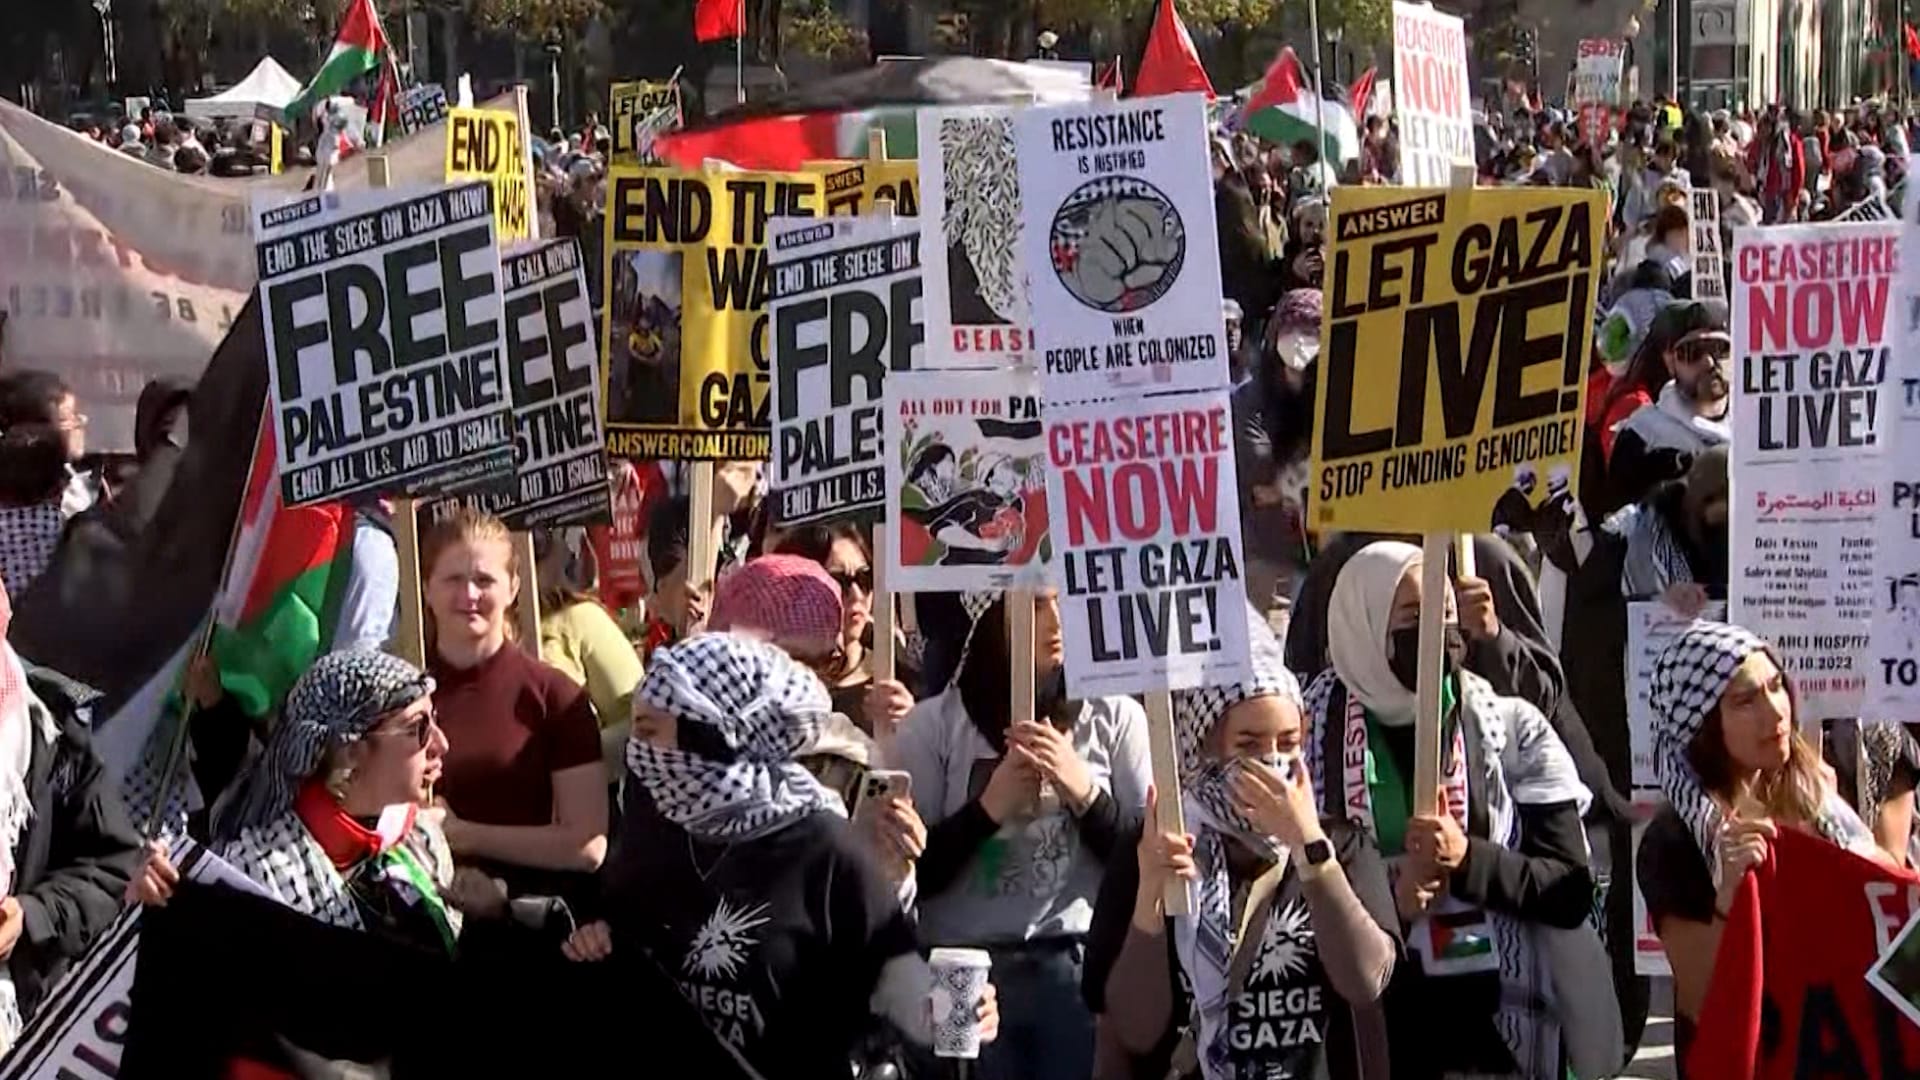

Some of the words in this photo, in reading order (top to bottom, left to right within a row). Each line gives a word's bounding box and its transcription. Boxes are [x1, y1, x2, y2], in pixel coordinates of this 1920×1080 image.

[402, 93, 449, 134] FREE
[1402, 53, 1462, 119] NOW
[452, 117, 500, 173] END
[1052, 109, 1165, 151] RESISTANCE
[1402, 114, 1430, 149] LET
[826, 169, 862, 190] SWER
[1078, 158, 1090, 174] IS
[1094, 150, 1146, 173] JUSTIFIED
[266, 241, 296, 275] END
[301, 235, 330, 264] THE
[335, 218, 377, 255] SIEGE
[381, 208, 404, 239] ON
[408, 198, 445, 233] GAZA
[450, 186, 488, 222] NOW!
[614, 177, 713, 243] END
[726, 181, 815, 244] THE
[1343, 200, 1440, 236] ANSWER
[1693, 192, 1715, 222] END
[516, 252, 547, 284] GAZA
[707, 248, 769, 311] WA
[775, 263, 805, 296] END
[811, 254, 839, 287] THE
[844, 247, 886, 281] SIEGE
[891, 239, 913, 271] ON
[1331, 232, 1439, 320] LET
[1451, 201, 1592, 296] GAZA
[1739, 236, 1899, 284] CEASEFIRE
[268, 223, 499, 402] FREE
[953, 328, 1036, 352] CEAS
[1112, 317, 1145, 338] WHEN
[1749, 277, 1890, 354] NOW
[504, 278, 592, 407] EE
[777, 276, 924, 423] FRE
[1045, 345, 1100, 375] PEOPLE
[1105, 342, 1134, 369] ARE
[1138, 334, 1216, 366] COLONIZED
[1322, 270, 1590, 462] LIVE!
[700, 371, 770, 428] GAZ
[1744, 353, 1800, 395] LET
[282, 347, 503, 464] PALESTINE!
[900, 400, 928, 416] ALL
[933, 400, 965, 415] OUT
[971, 400, 1002, 415] FOR
[1009, 396, 1043, 420] PA
[1758, 389, 1878, 451] LIVE!
[292, 466, 323, 502] END
[330, 457, 363, 489] ALL
[365, 446, 398, 477] U.S.
[402, 436, 430, 470] AID
[433, 427, 452, 459] TO
[457, 412, 512, 453] ISRAEL
[1048, 408, 1229, 468] CEASEFIRE
[1320, 461, 1373, 502] STOP
[1381, 440, 1467, 492] FUNDING
[1476, 417, 1577, 474] GENOCIDE!
[519, 471, 544, 503] AID
[549, 467, 566, 495] TO
[567, 452, 605, 489] ISRAEL
[782, 486, 812, 519] END
[817, 477, 848, 510] ALL
[851, 470, 884, 501] U.S.
[1063, 456, 1218, 547] NOW
[1064, 547, 1128, 596] LET
[1138, 536, 1239, 590] GAZA
[1086, 586, 1223, 663] LIVE!
[1237, 985, 1322, 1019] SIEGE
[1229, 1017, 1323, 1050] GAZA
